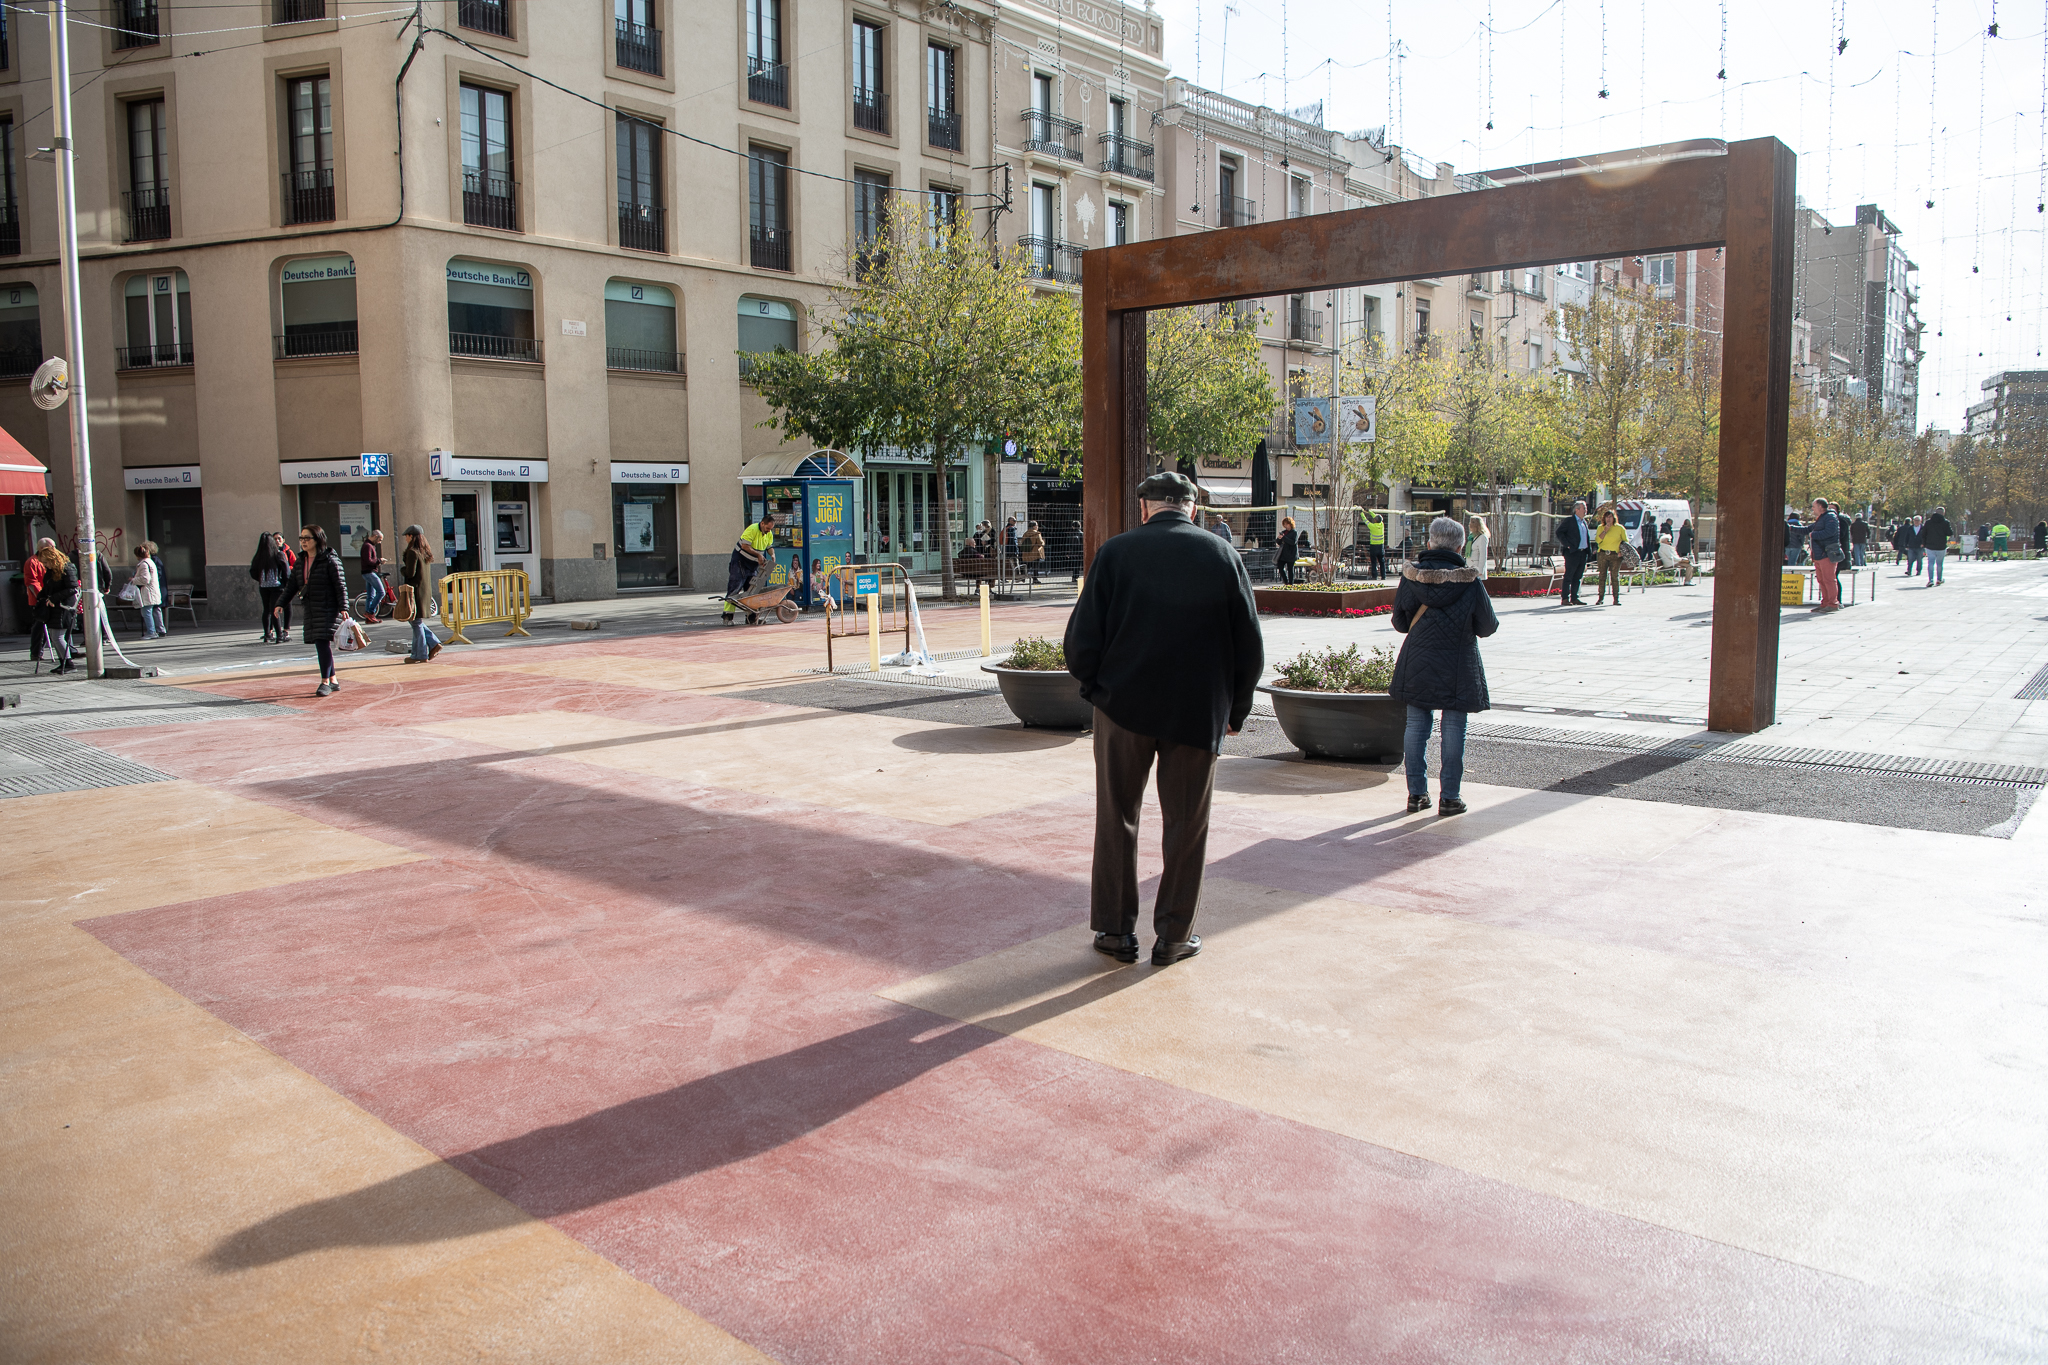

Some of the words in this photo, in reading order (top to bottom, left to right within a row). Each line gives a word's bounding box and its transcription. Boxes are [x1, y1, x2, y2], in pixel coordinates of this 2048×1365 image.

[284, 268, 324, 280] Deutsche
[327, 266, 349, 277] Bank
[446, 267, 490, 282] Deutsche
[492, 273, 516, 285] Bank
[1202, 458, 1243, 469] Centenari
[297, 471, 329, 479] Deutsche
[330, 470, 348, 478] Bank
[460, 468, 496, 476] Deutsche
[497, 468, 516, 476] Bank
[817, 495, 843, 507] BEN
[815, 507, 843, 523] JUGAT
[823, 556, 841, 565] BEN
[768, 573, 786, 584] JUGAT
